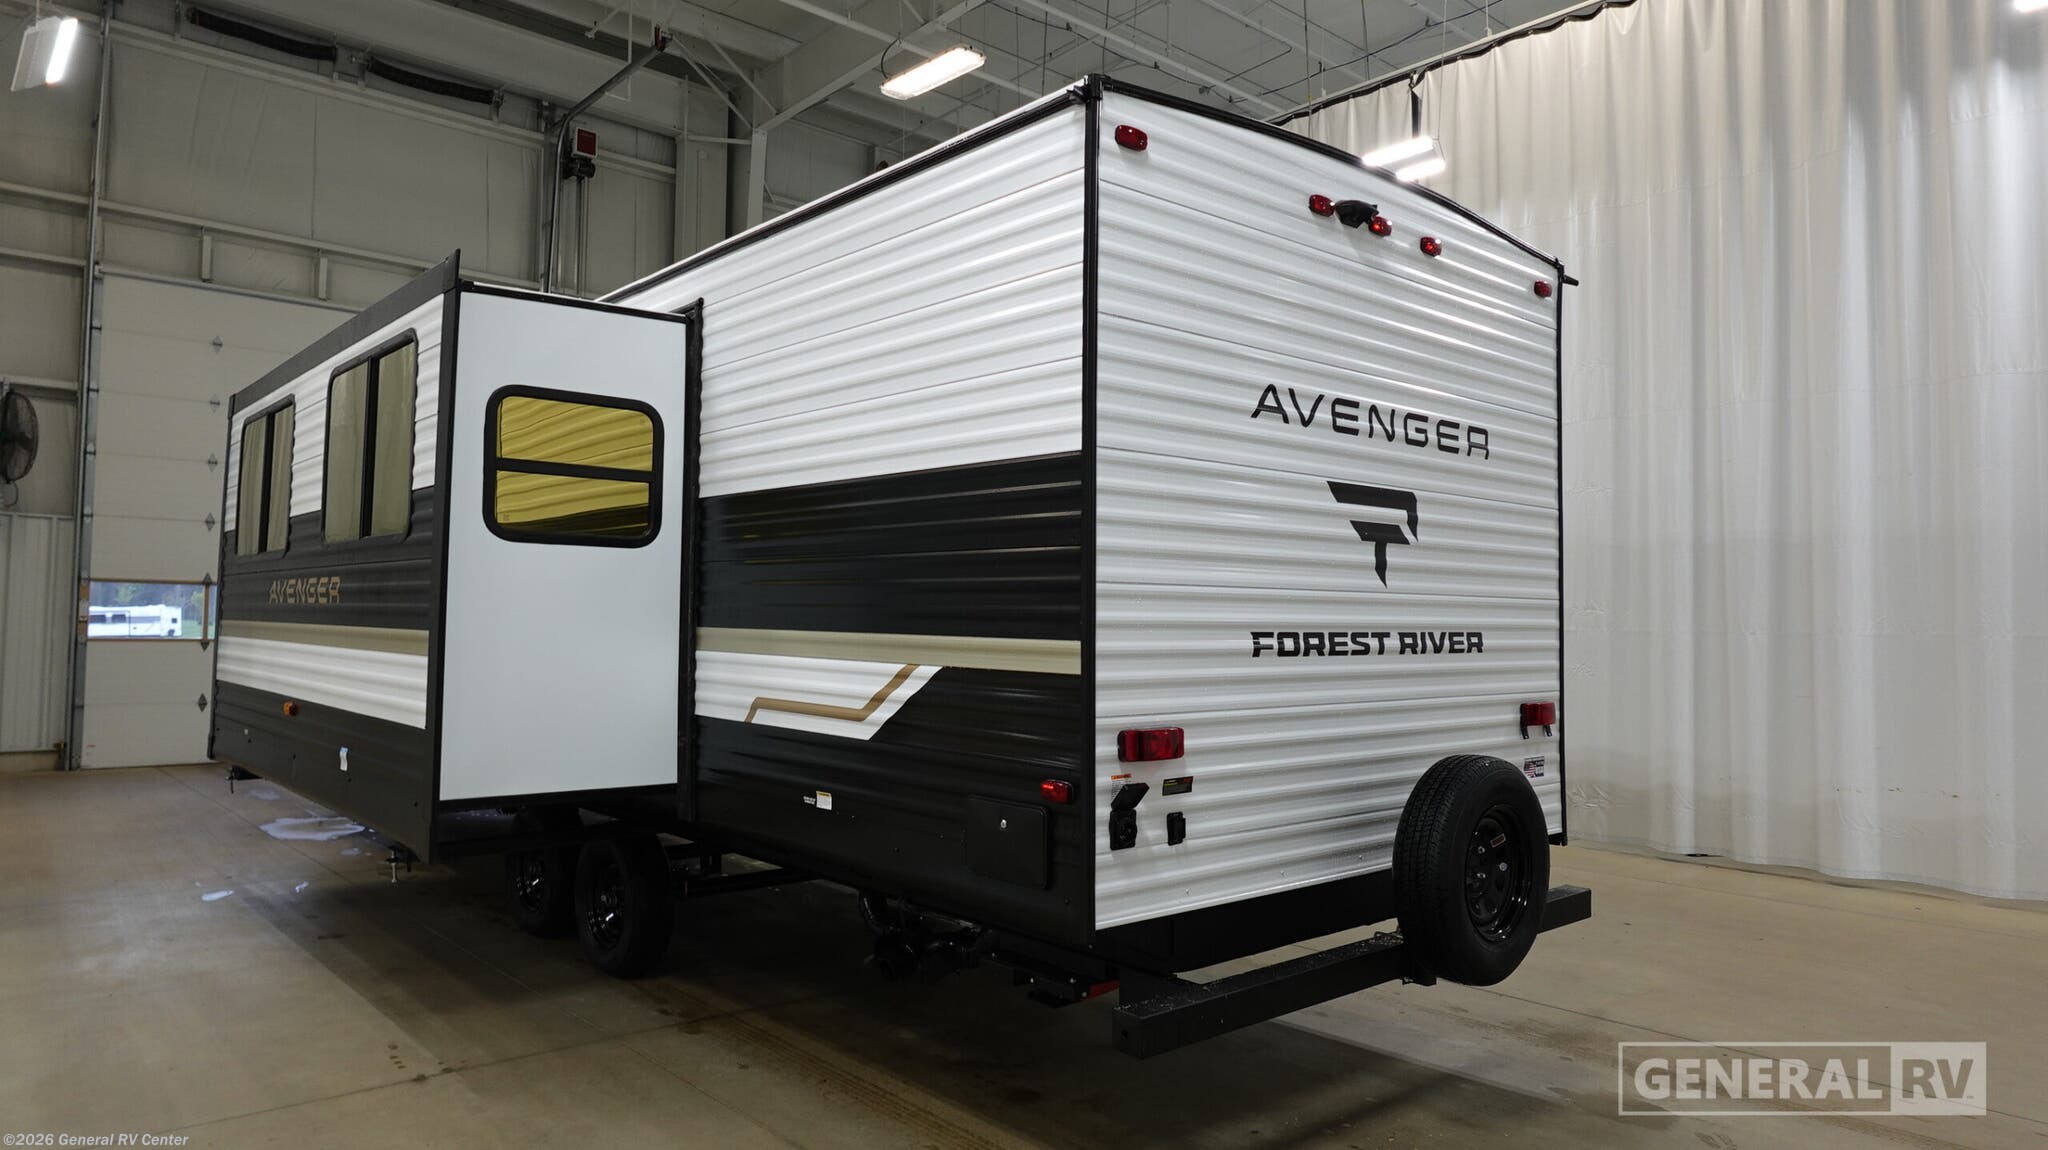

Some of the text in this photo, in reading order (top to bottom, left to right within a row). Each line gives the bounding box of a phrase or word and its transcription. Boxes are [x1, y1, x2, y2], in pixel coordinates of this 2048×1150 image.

[1251, 383, 1489, 460] AVENGER
[268, 576, 341, 605] AVENGER
[1250, 631, 1484, 658] FOREST RIVER
